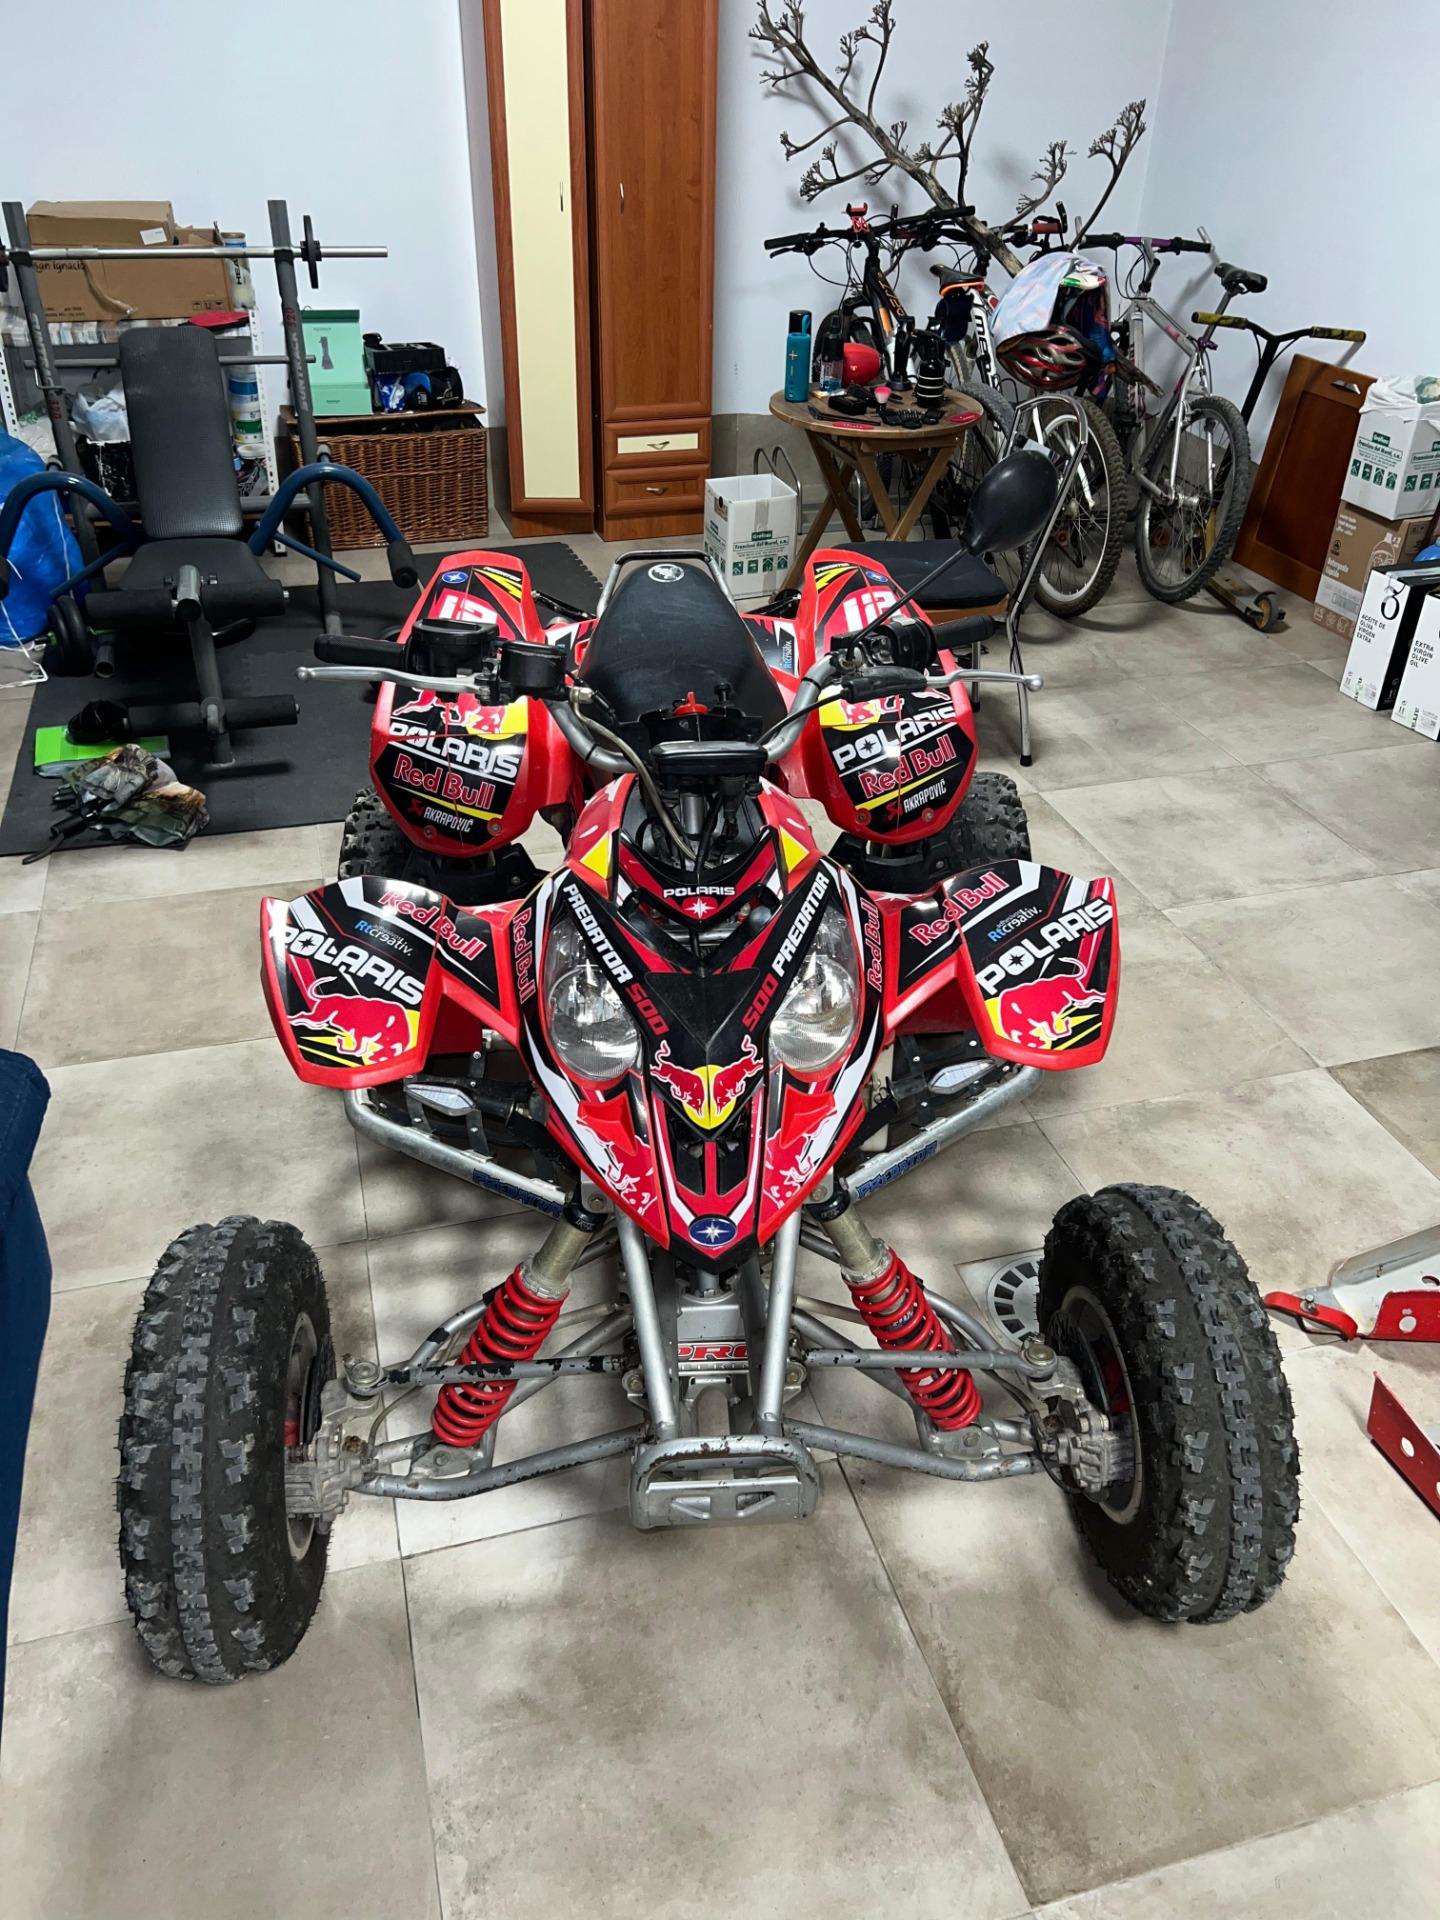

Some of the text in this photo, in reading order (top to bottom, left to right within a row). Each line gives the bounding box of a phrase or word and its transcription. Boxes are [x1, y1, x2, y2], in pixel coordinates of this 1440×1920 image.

[1356, 632, 1372, 644] EXTRA
[1358, 627, 1376, 639] VIRGEN
[1359, 620, 1374, 631] OLIVA
[1361, 614, 1379, 626] ACEITE
[1414, 640, 1435, 652] EXTRA
[1409, 659, 1419, 668] OIL
[1411, 653, 1430, 665] OLIVE
[1413, 646, 1434, 659] VIRGIN
[388, 721, 520, 780] POLARIS
[832, 706, 957, 771] POLARIS
[857, 732, 958, 800] Red Bull
[393, 752, 496, 811] Red Bull
[663, 886, 736, 898] POLARIS
[908, 870, 1011, 947] Red Bull
[377, 890, 488, 961] Red Bull
[742, 871, 831, 1033] 500 PREDATOR
[860, 897, 883, 993] Red Bull
[975, 898, 1114, 997] POLARIS
[274, 925, 426, 1006] POLARIS
[512, 906, 538, 1005] Red Bull
[563, 883, 671, 1037] PREDATOR 500
